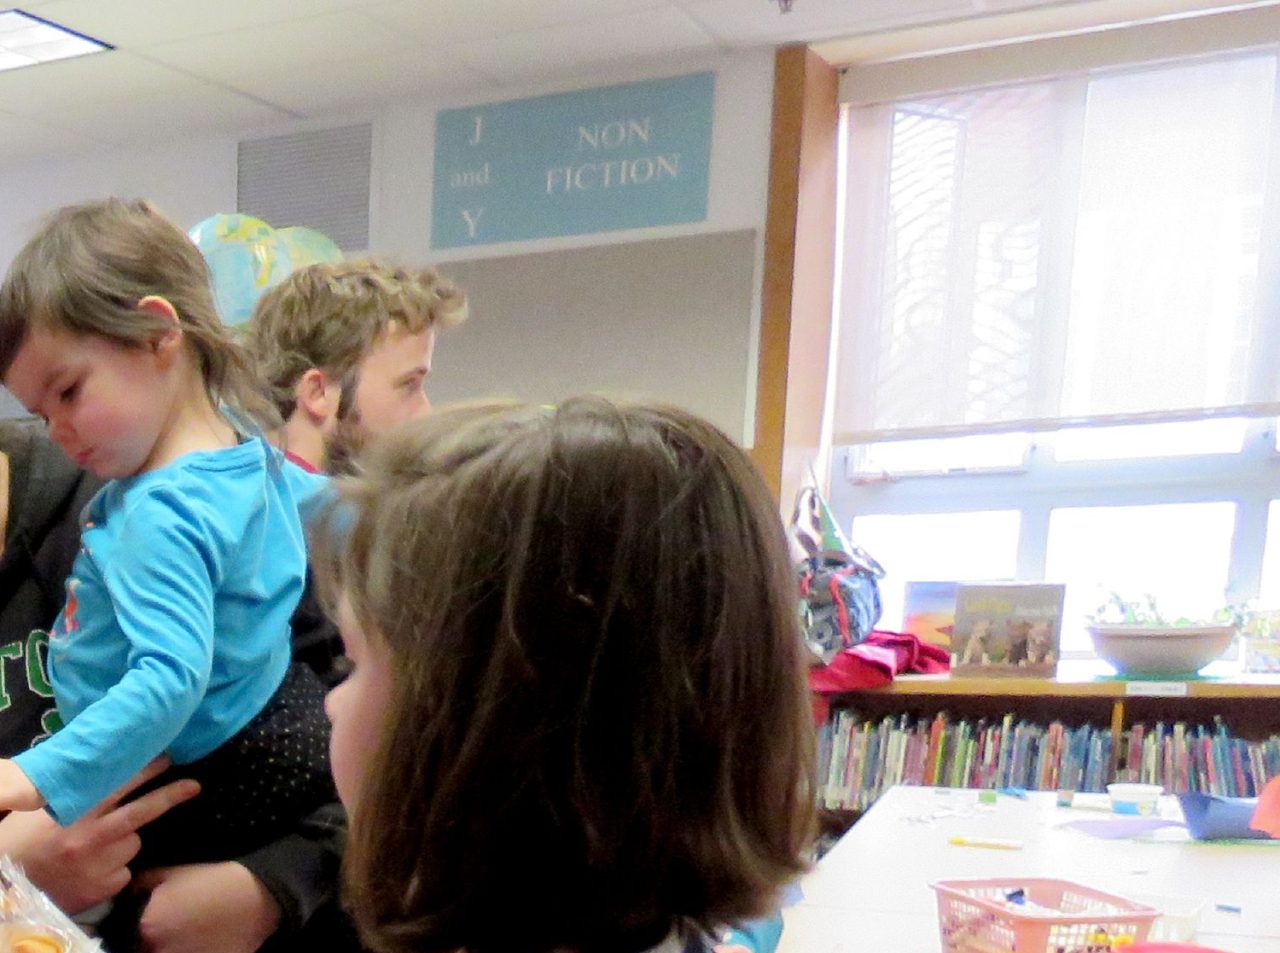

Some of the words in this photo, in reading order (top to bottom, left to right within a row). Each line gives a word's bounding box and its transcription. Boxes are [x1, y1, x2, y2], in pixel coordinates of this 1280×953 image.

[468, 115, 483, 146] J
[578, 117, 651, 150] NON
[450, 163, 490, 187] and
[546, 152, 682, 193] FICTION
[461, 207, 483, 238] Y
